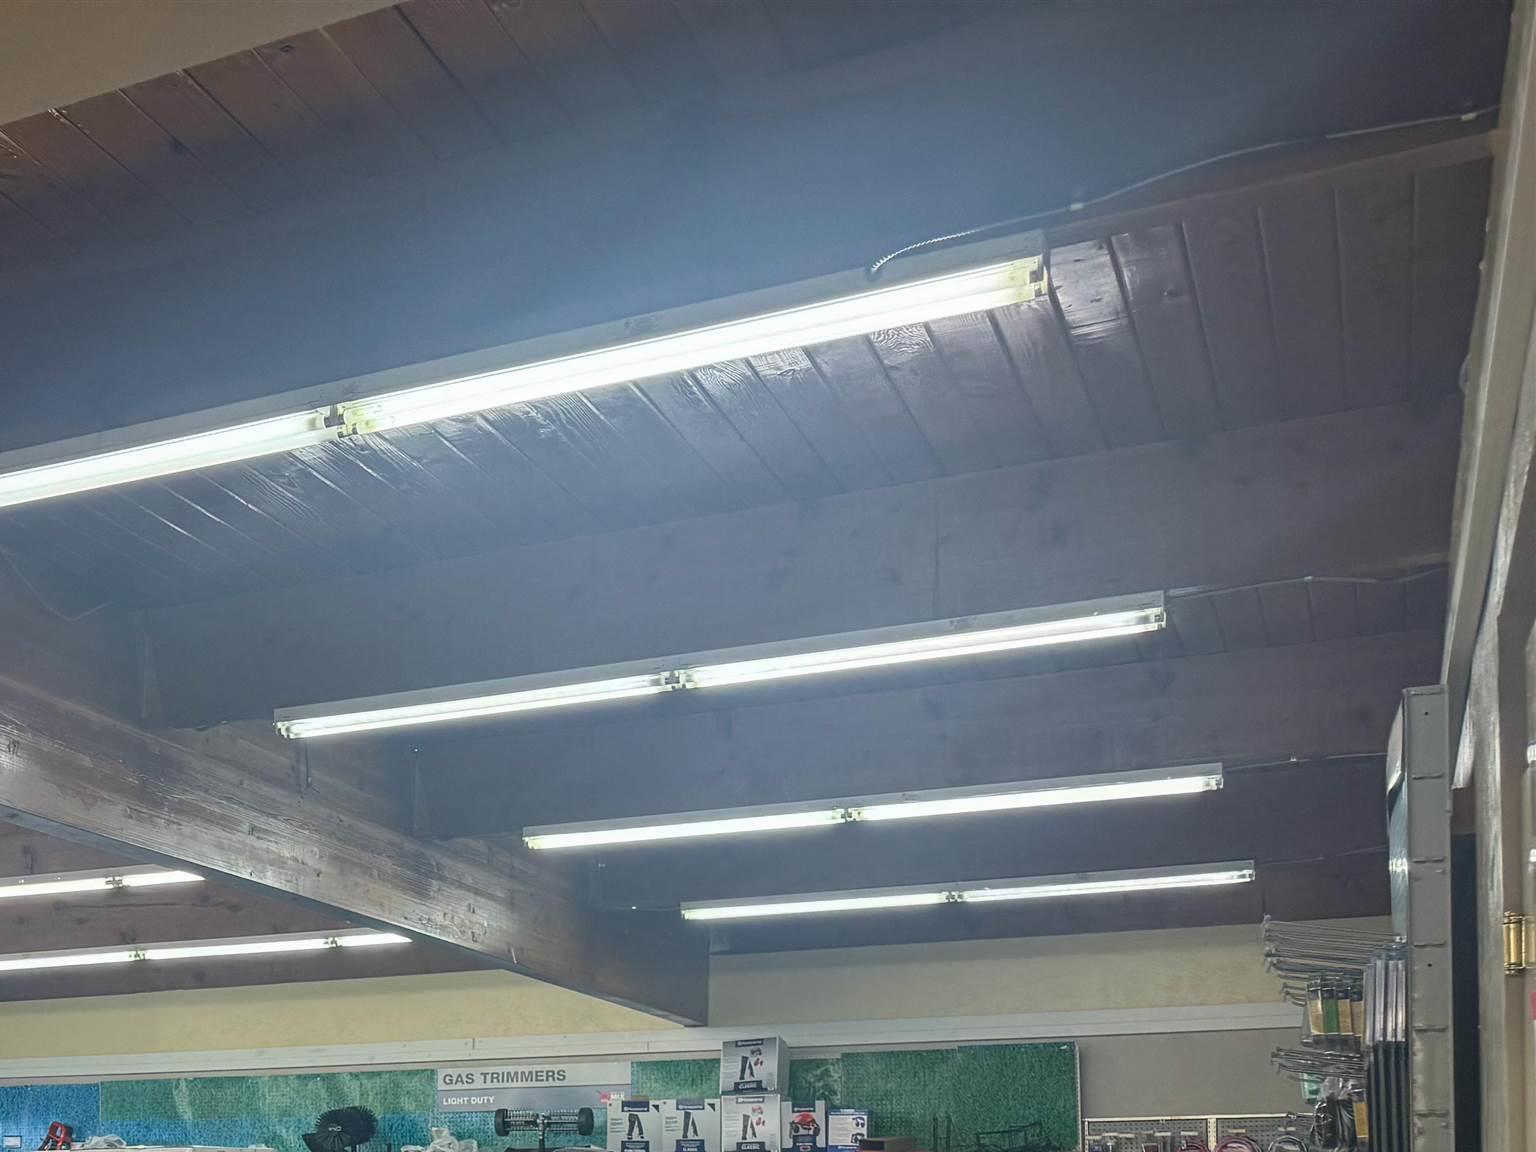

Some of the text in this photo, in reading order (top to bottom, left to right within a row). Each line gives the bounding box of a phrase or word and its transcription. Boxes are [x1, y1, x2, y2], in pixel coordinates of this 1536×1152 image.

[443, 1069, 567, 1086] GAS TRIMMERS
[442, 1095, 495, 1105] LIGHT DUTY
